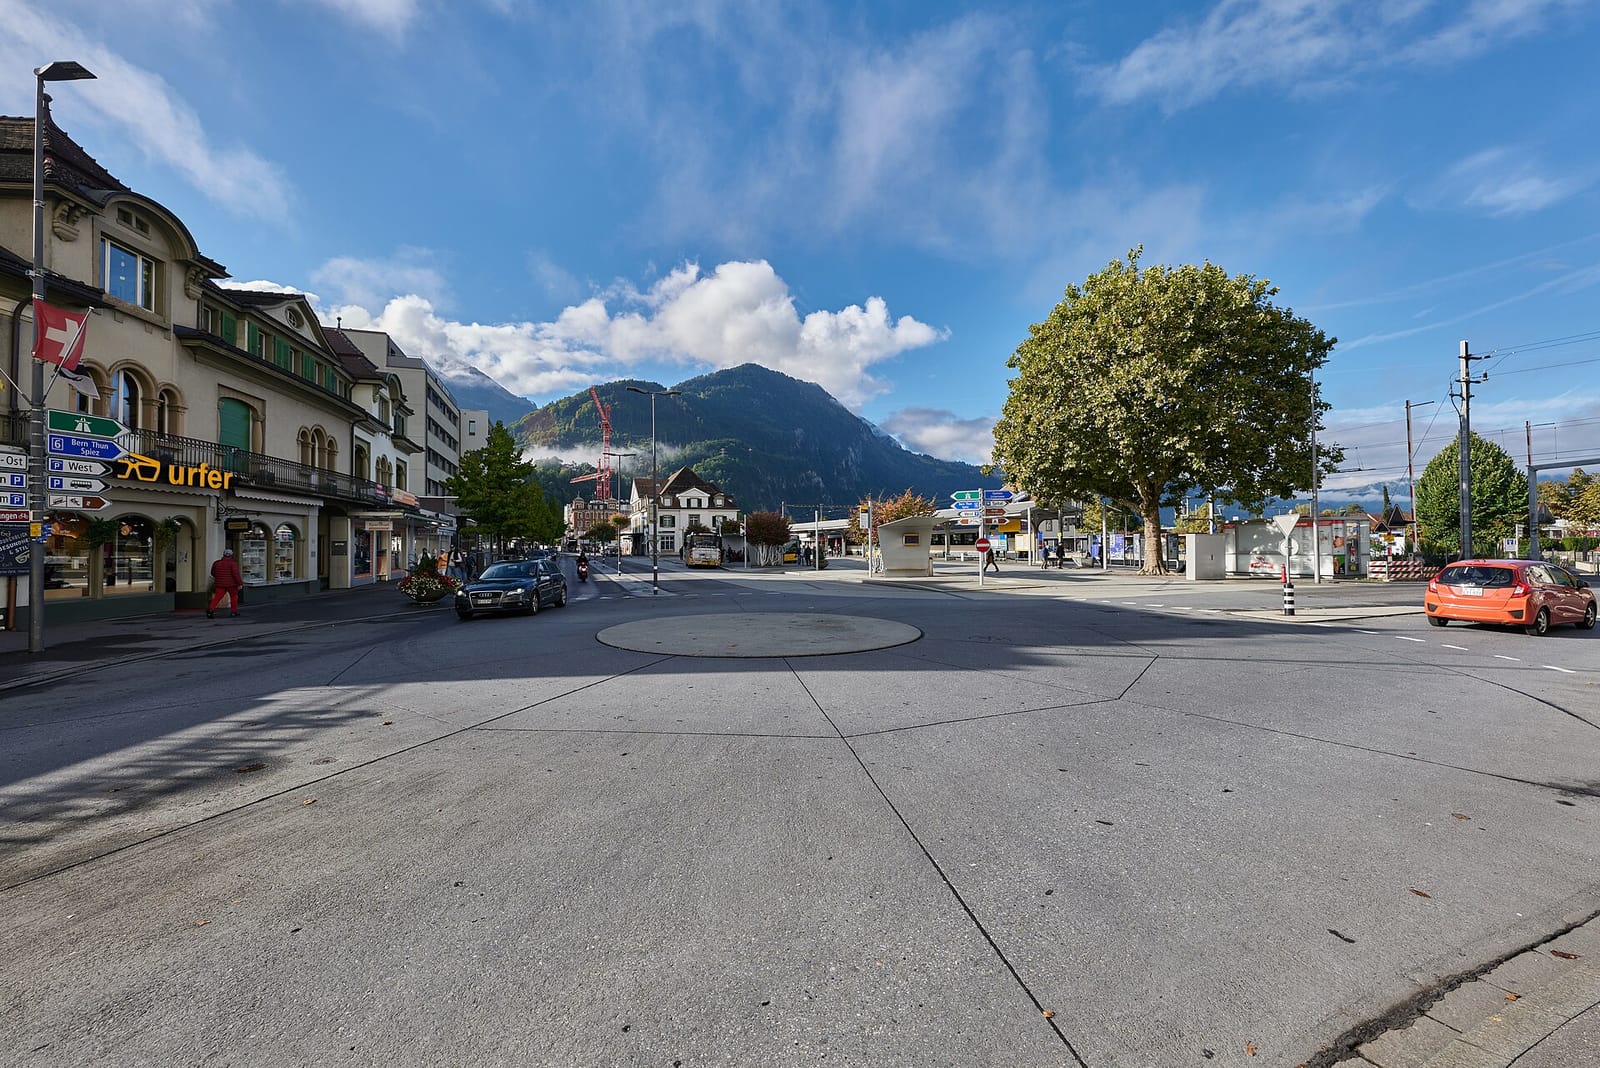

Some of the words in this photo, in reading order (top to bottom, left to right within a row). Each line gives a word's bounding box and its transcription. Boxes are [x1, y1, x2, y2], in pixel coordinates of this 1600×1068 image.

[54, 439, 61, 449] 6
[71, 438, 89, 447] Bern
[92, 441, 109, 450] Thun
[80, 447, 100, 456] Spiez
[68, 461, 93, 472] West
[168, 462, 234, 490] urfer
